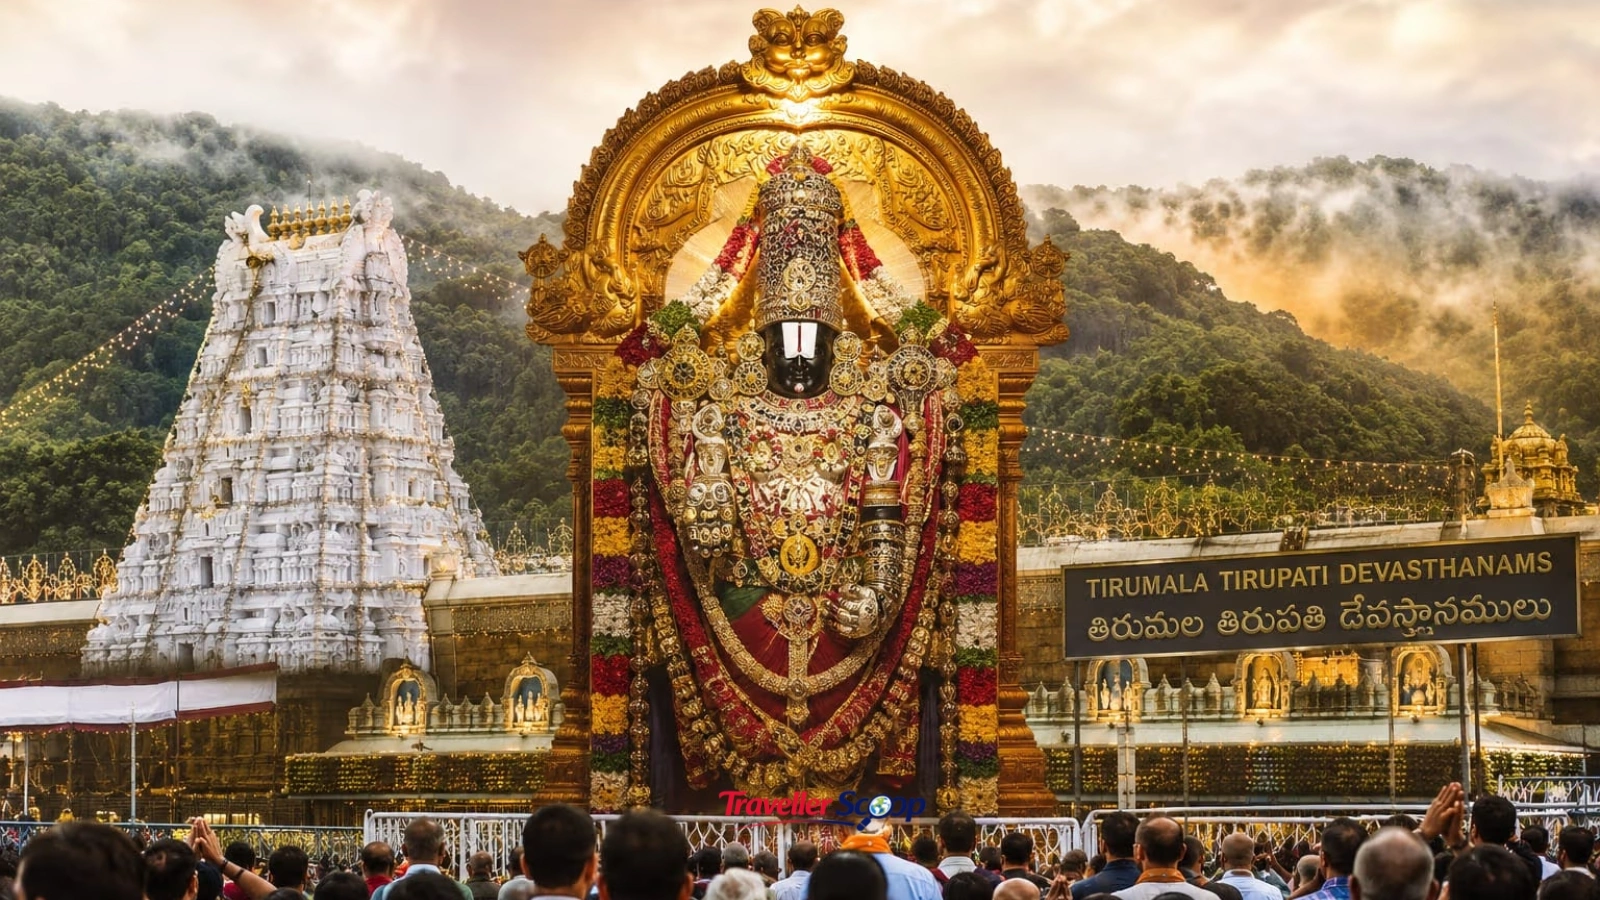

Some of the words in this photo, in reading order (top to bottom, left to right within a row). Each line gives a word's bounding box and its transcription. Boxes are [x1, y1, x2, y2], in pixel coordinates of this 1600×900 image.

[1086, 572, 1209, 599] TIRUMALA
[1219, 564, 1329, 591] TIRUPATI
[1340, 551, 1553, 585] DEVASTHANAMS
[1087, 610, 1204, 641] తిరుమల
[1217, 604, 1326, 635] తిరుపతి
